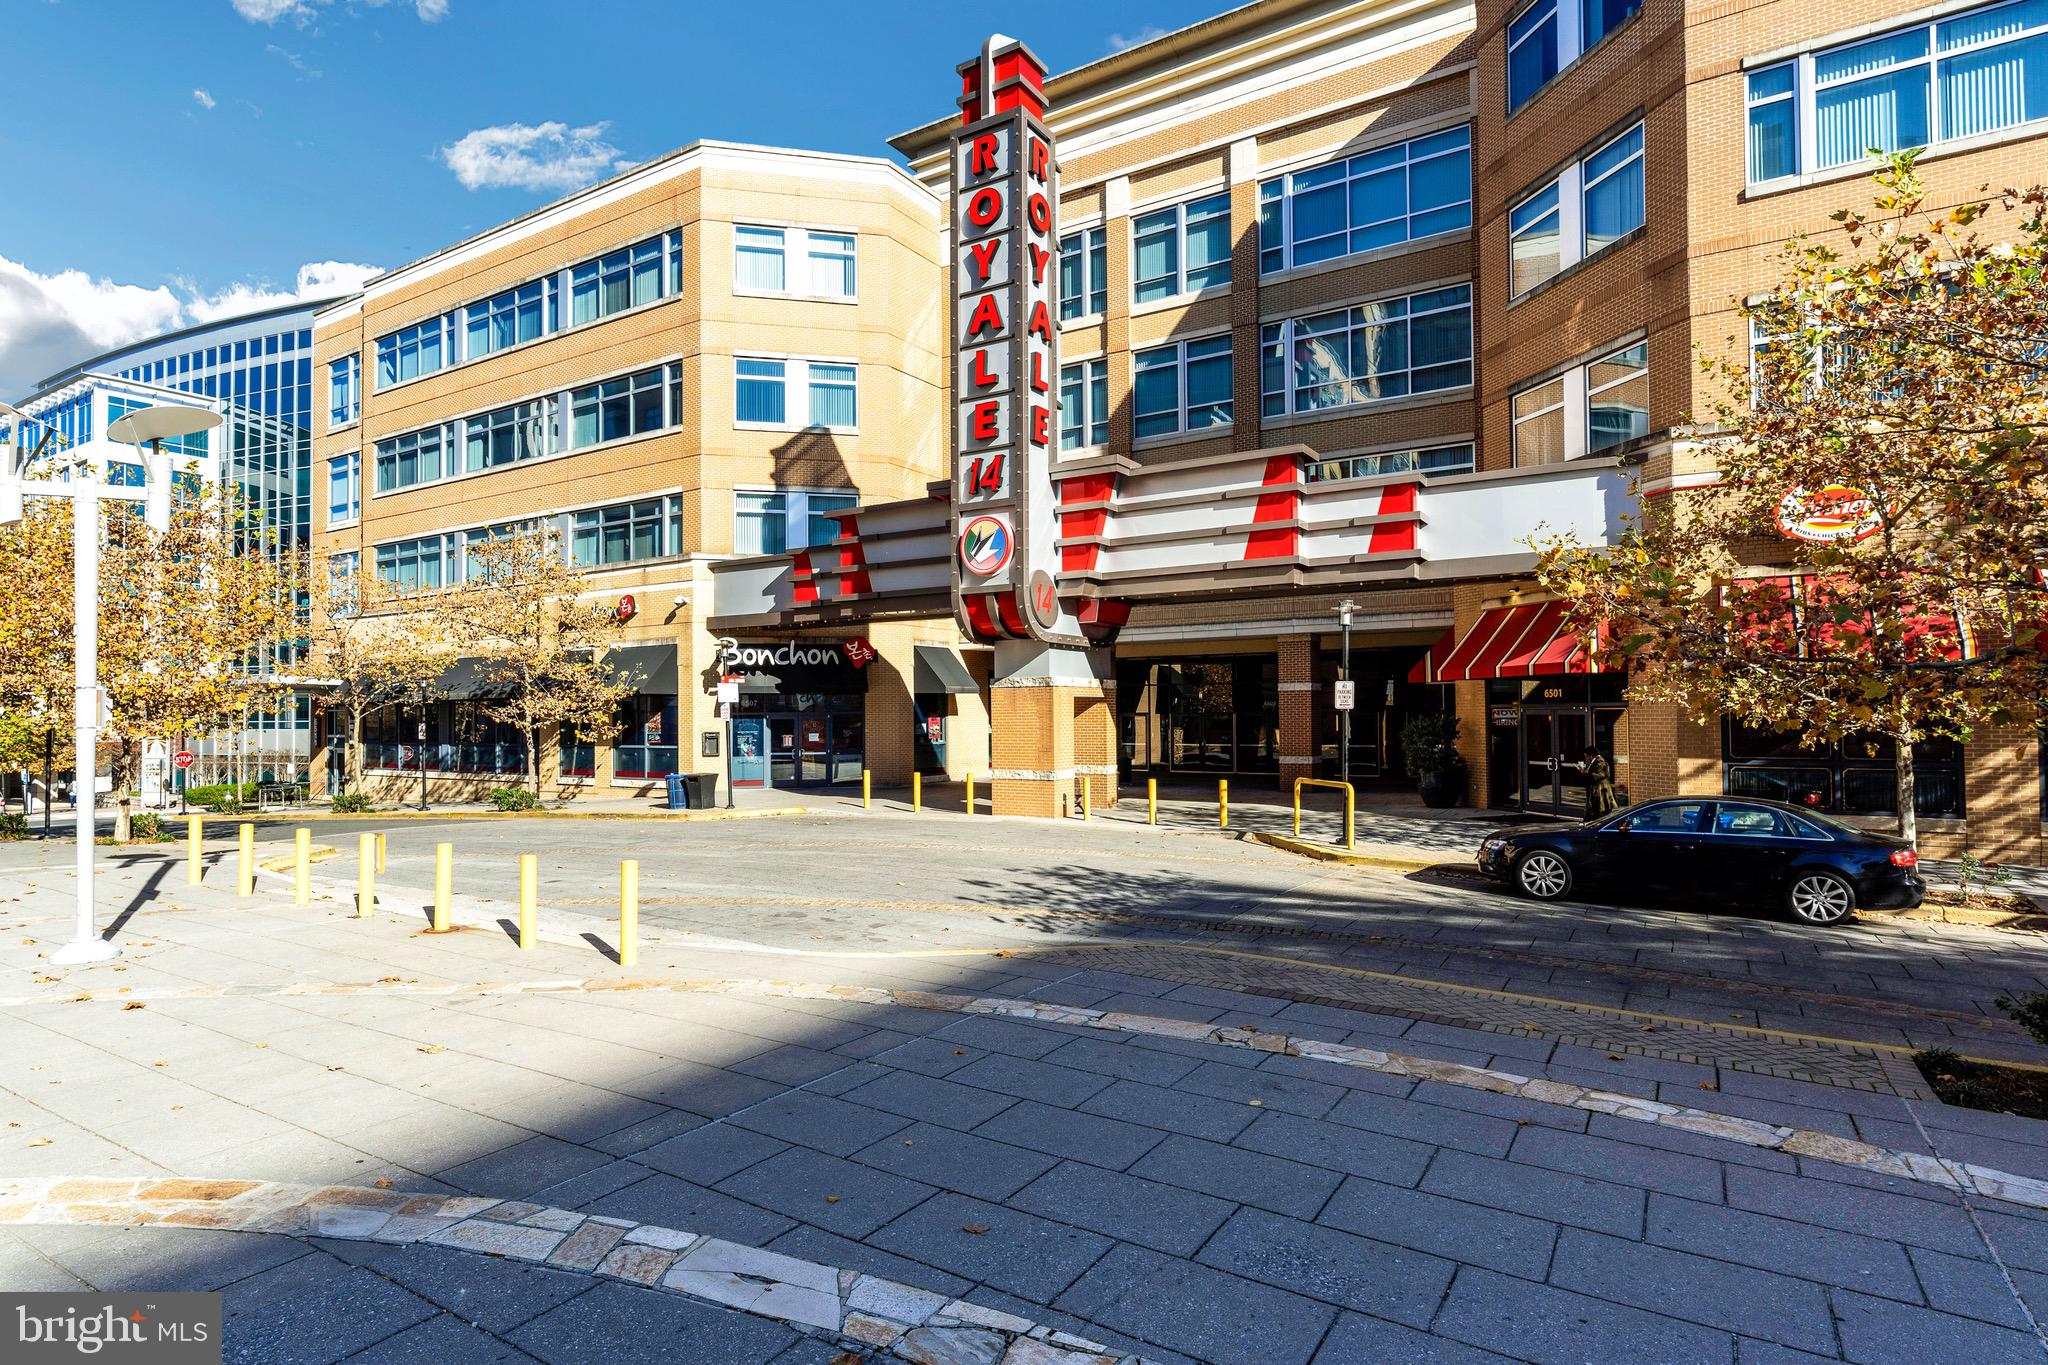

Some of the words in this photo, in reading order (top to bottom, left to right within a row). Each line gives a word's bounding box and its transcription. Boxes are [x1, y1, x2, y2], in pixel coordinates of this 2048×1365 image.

[969, 133, 1004, 441] ROYALE
[1028, 136, 1051, 446] ROYALE
[970, 454, 1006, 495] 14
[1795, 527, 1811, 536] RIBS
[1817, 530, 1851, 538] CHICKEN
[1036, 583, 1053, 613] 14
[719, 637, 839, 666] Bonchon
[1544, 688, 1562, 698] 6501
[1492, 709, 1518, 717] NOW
[175, 755, 193, 763] STOP
